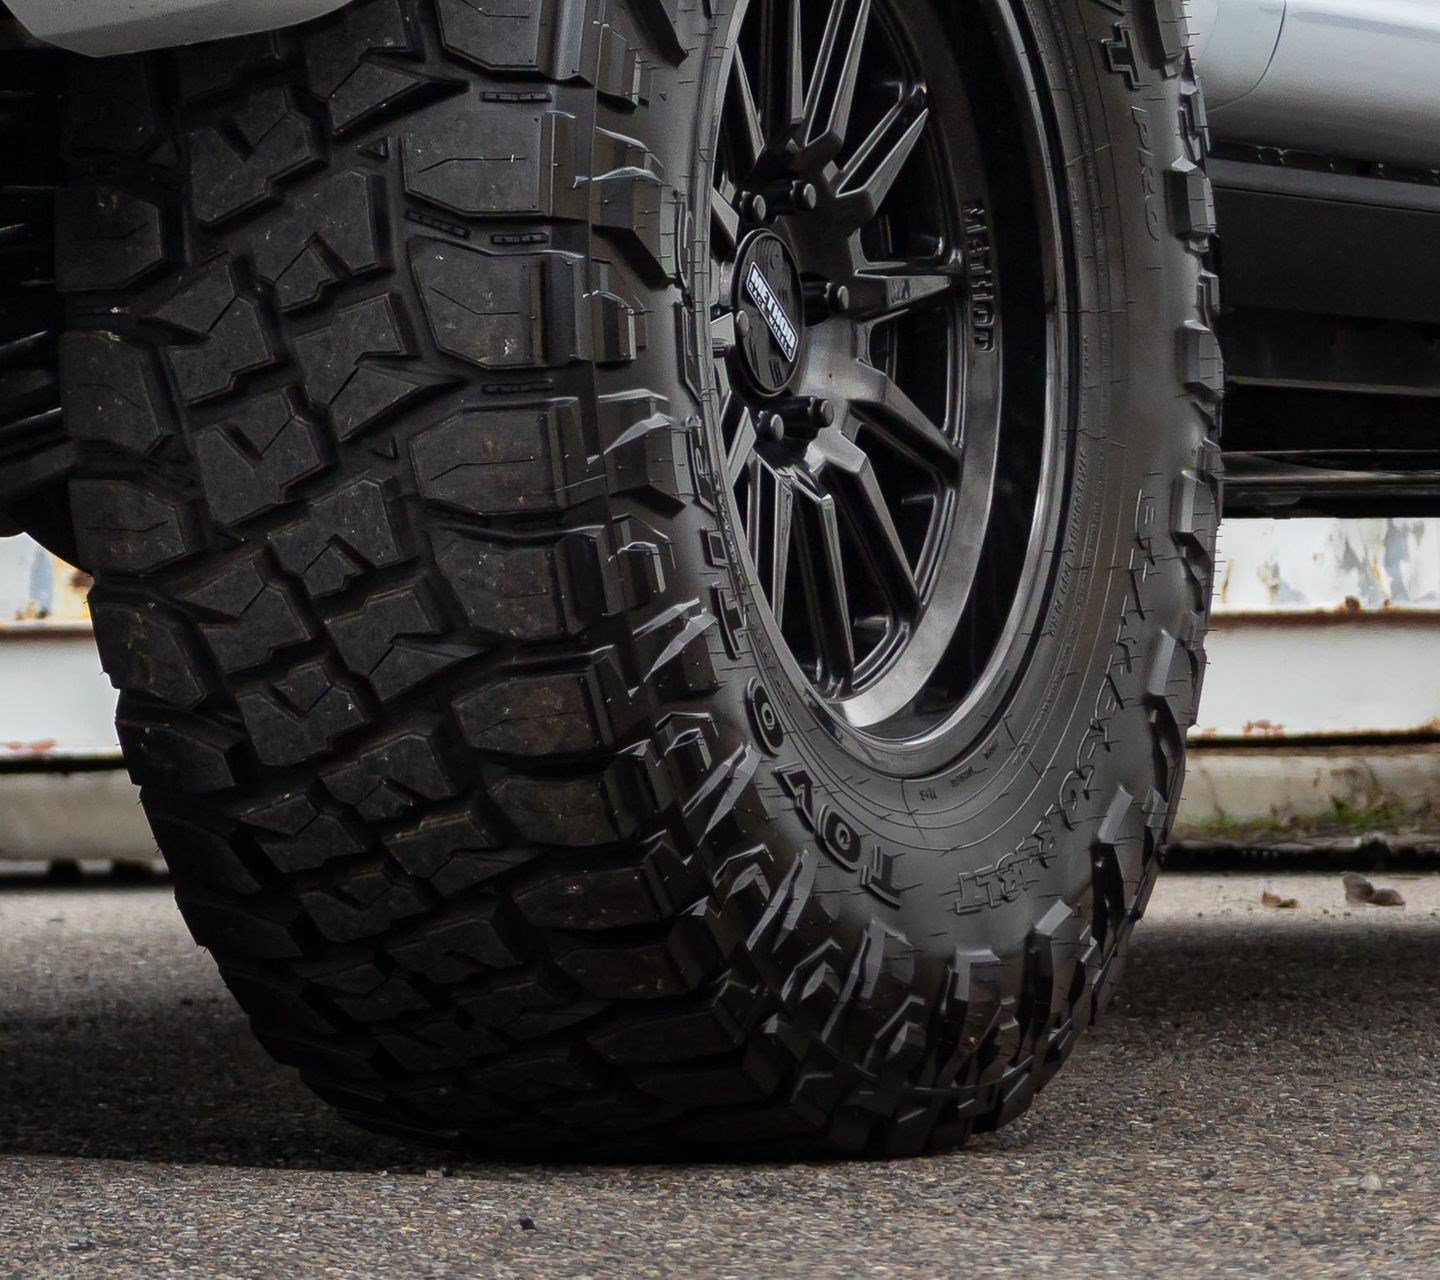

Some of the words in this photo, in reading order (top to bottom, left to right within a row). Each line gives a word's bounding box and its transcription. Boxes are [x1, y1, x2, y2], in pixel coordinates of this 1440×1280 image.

[1130, 105, 1160, 242] PRO
[747, 281, 767, 313] RACE
[750, 266, 796, 350] METHOD
[961, 202, 996, 353] METHOD
[747, 676, 904, 911] TOYO
